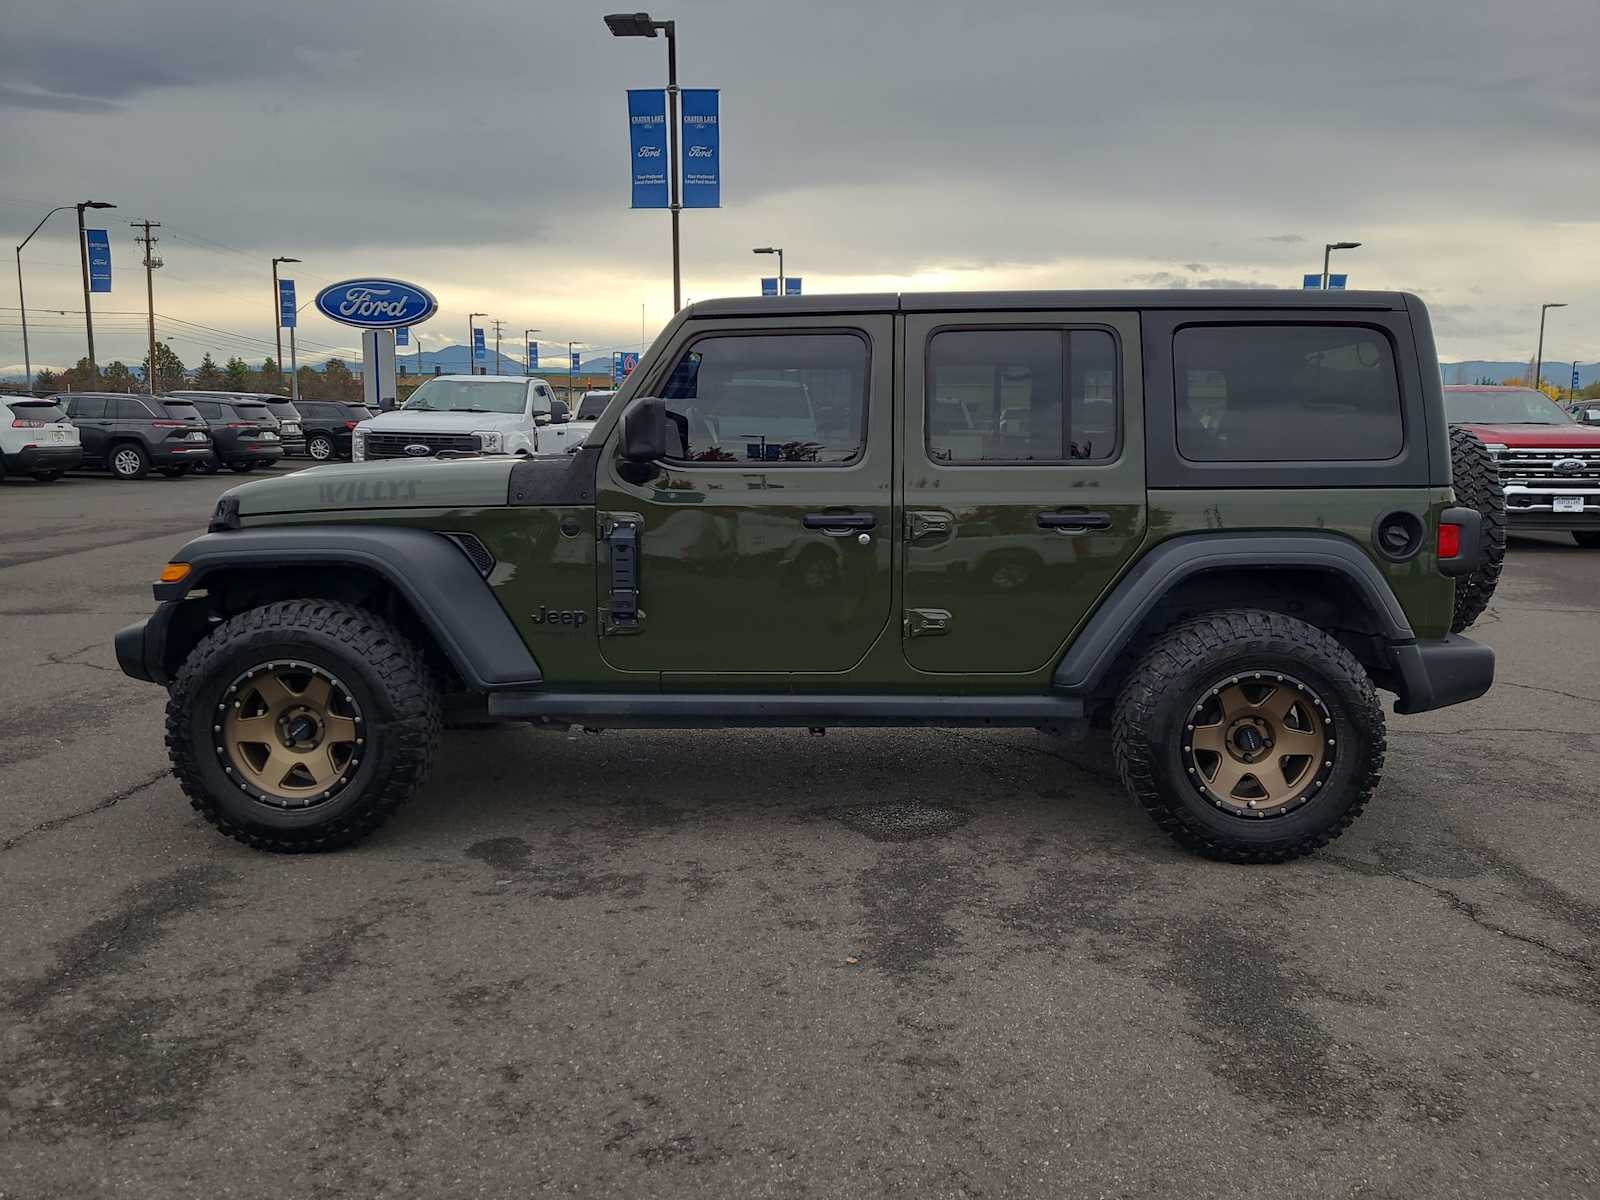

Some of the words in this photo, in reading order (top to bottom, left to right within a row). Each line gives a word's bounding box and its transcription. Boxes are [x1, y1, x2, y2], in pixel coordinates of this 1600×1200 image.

[638, 145, 661, 158] Ford
[688, 145, 713, 158] Ford
[339, 287, 408, 317] Ford
[320, 479, 422, 503] WILLYS
[531, 605, 588, 628] Jeep
